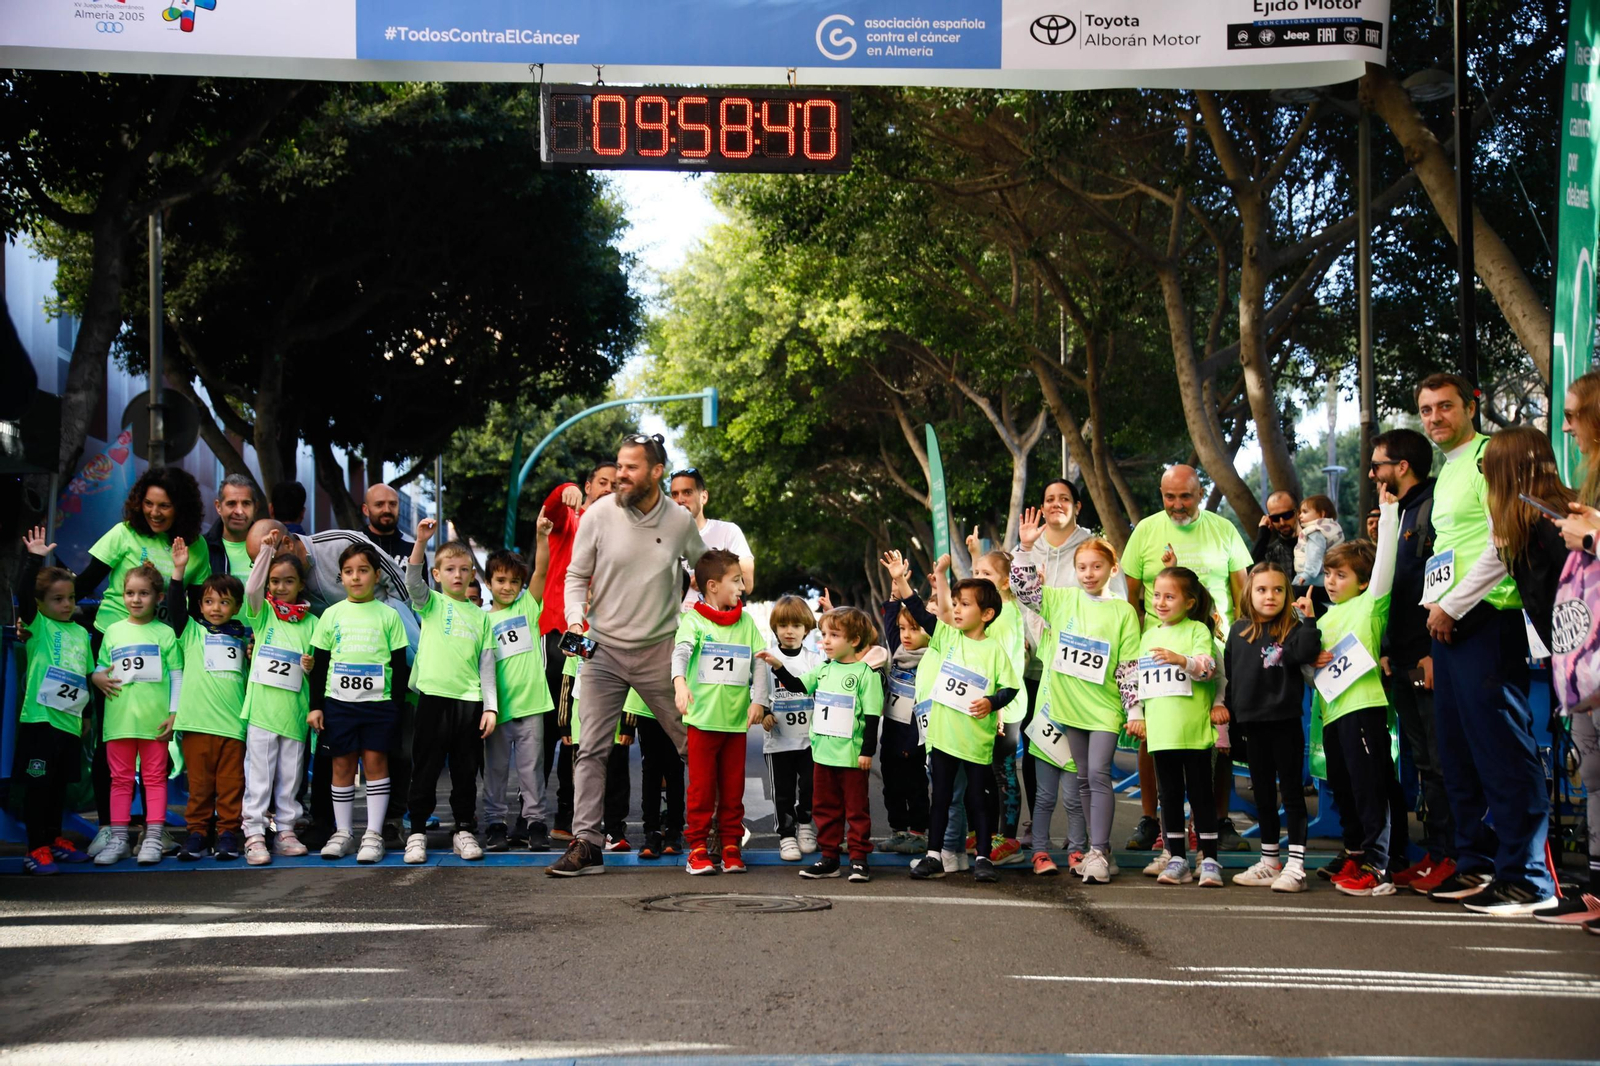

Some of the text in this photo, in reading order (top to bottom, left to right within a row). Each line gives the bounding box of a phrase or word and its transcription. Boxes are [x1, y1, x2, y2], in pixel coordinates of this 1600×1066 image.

[118, 11, 145, 21] 2005
[1253, 0, 1361, 16] Ejido Motor
[864, 18, 986, 31] asociación española
[1085, 14, 1140, 29] Toyota
[384, 26, 580, 45] #TodosContraElCáncer
[866, 31, 961, 43] contra el cáncer
[1084, 34, 1201, 46] Alborán Motor
[1283, 30, 1310, 41] Jeep
[1317, 28, 1337, 43] FIAT
[1365, 28, 1380, 44] FIAT
[866, 45, 934, 57] en Almería
[1427, 565, 1451, 590] 1043
[497, 630, 518, 646] 18
[227, 647, 237, 659] 3
[1061, 646, 1104, 669] 1129
[122, 656, 144, 672] 99
[267, 659, 292, 677] 22
[712, 656, 734, 672] 21
[1328, 655, 1353, 679] 32
[340, 675, 373, 691] 886
[1143, 667, 1187, 684] 1116
[56, 683, 79, 702] 24
[945, 677, 968, 697] 95
[785, 711, 808, 726] 98
[821, 705, 829, 721] 1
[918, 714, 928, 730] 15
[1042, 723, 1063, 745] 31
